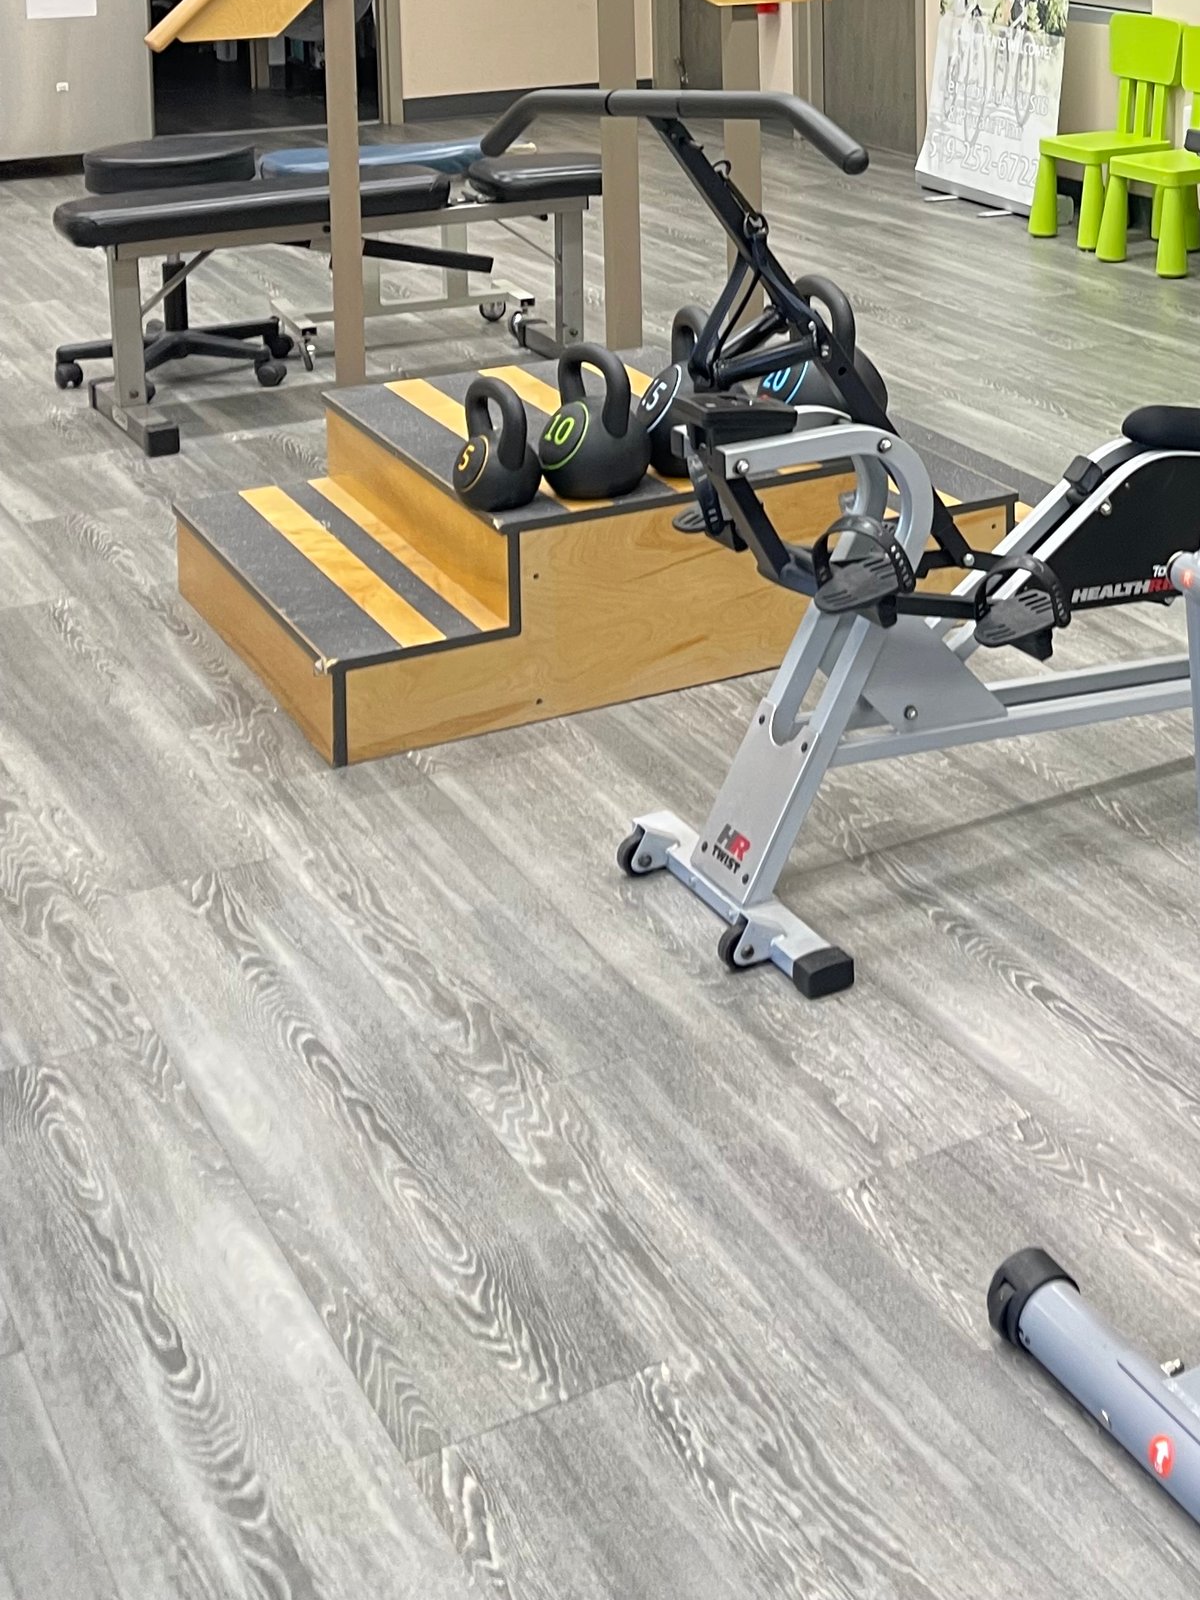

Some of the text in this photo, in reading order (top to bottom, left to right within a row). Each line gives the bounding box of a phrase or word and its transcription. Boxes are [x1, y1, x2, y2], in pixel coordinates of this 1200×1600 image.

[544, 414, 576, 446] 10
[458, 445, 475, 472] 5
[711, 843, 741, 875] TWIST
